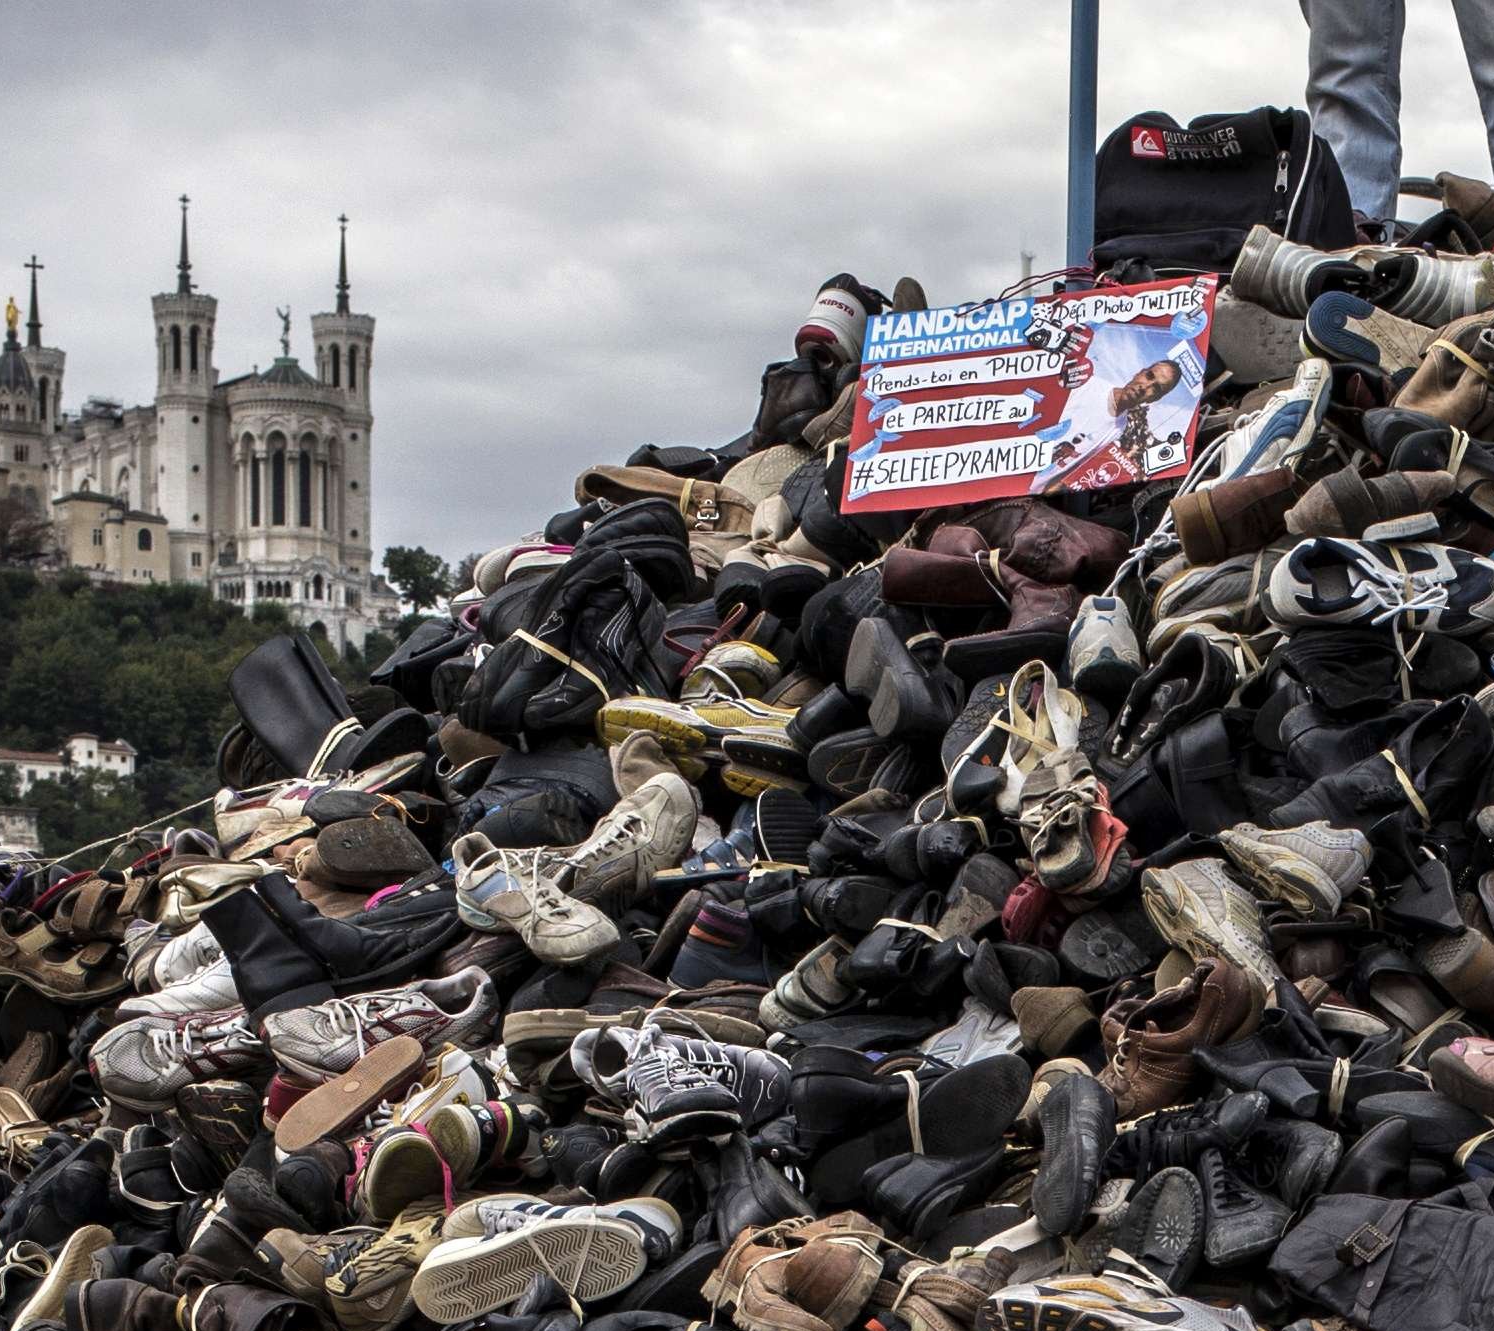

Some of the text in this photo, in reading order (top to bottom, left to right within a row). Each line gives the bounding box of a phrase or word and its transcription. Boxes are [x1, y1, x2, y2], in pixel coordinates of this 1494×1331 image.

[871, 300, 1028, 342] HANDICAP
[1057, 288, 1200, 323] Défi Photo TWITTER
[868, 329, 1023, 360] INTERNATIONAL
[959, 370, 978, 381] en
[986, 352, 1061, 377] PHOTO
[886, 398, 1028, 428] et PARTICIPE au
